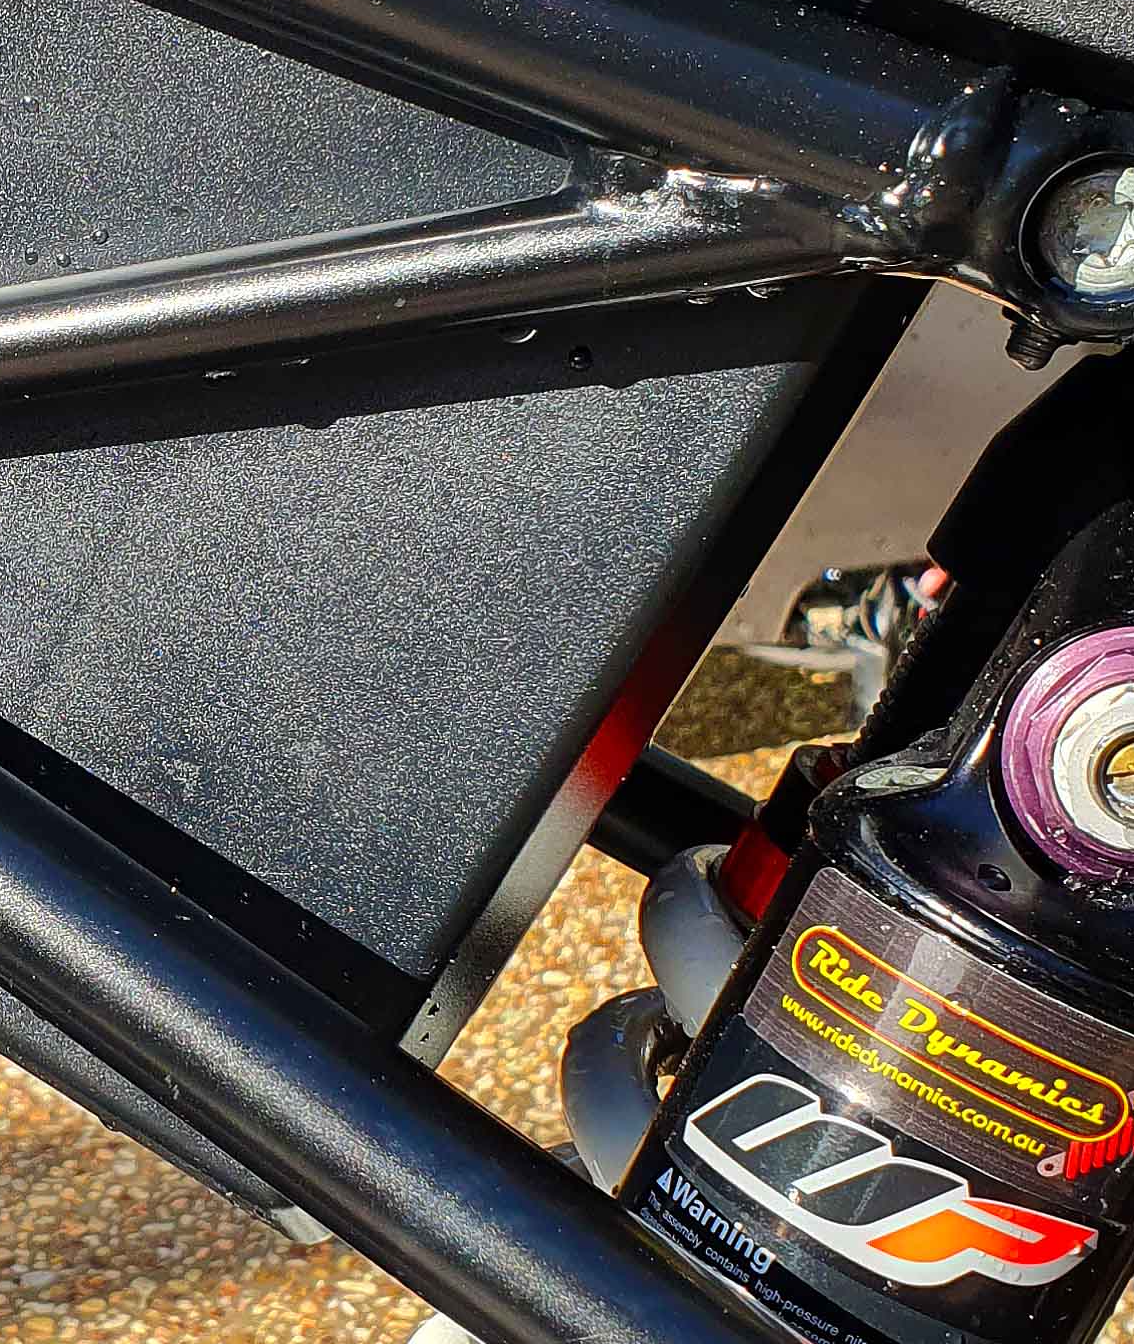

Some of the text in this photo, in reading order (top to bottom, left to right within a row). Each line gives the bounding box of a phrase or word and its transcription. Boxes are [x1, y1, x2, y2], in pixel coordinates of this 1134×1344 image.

[781, 994, 1047, 1157] www.ridedynamics.com.au
[807, 939, 1107, 1125] Ride Dynamics
[662, 1209, 703, 1249] assembly
[705, 1246, 751, 1283] contains
[754, 1278, 840, 1336] high-pressure
[672, 1175, 775, 1275] Warning
